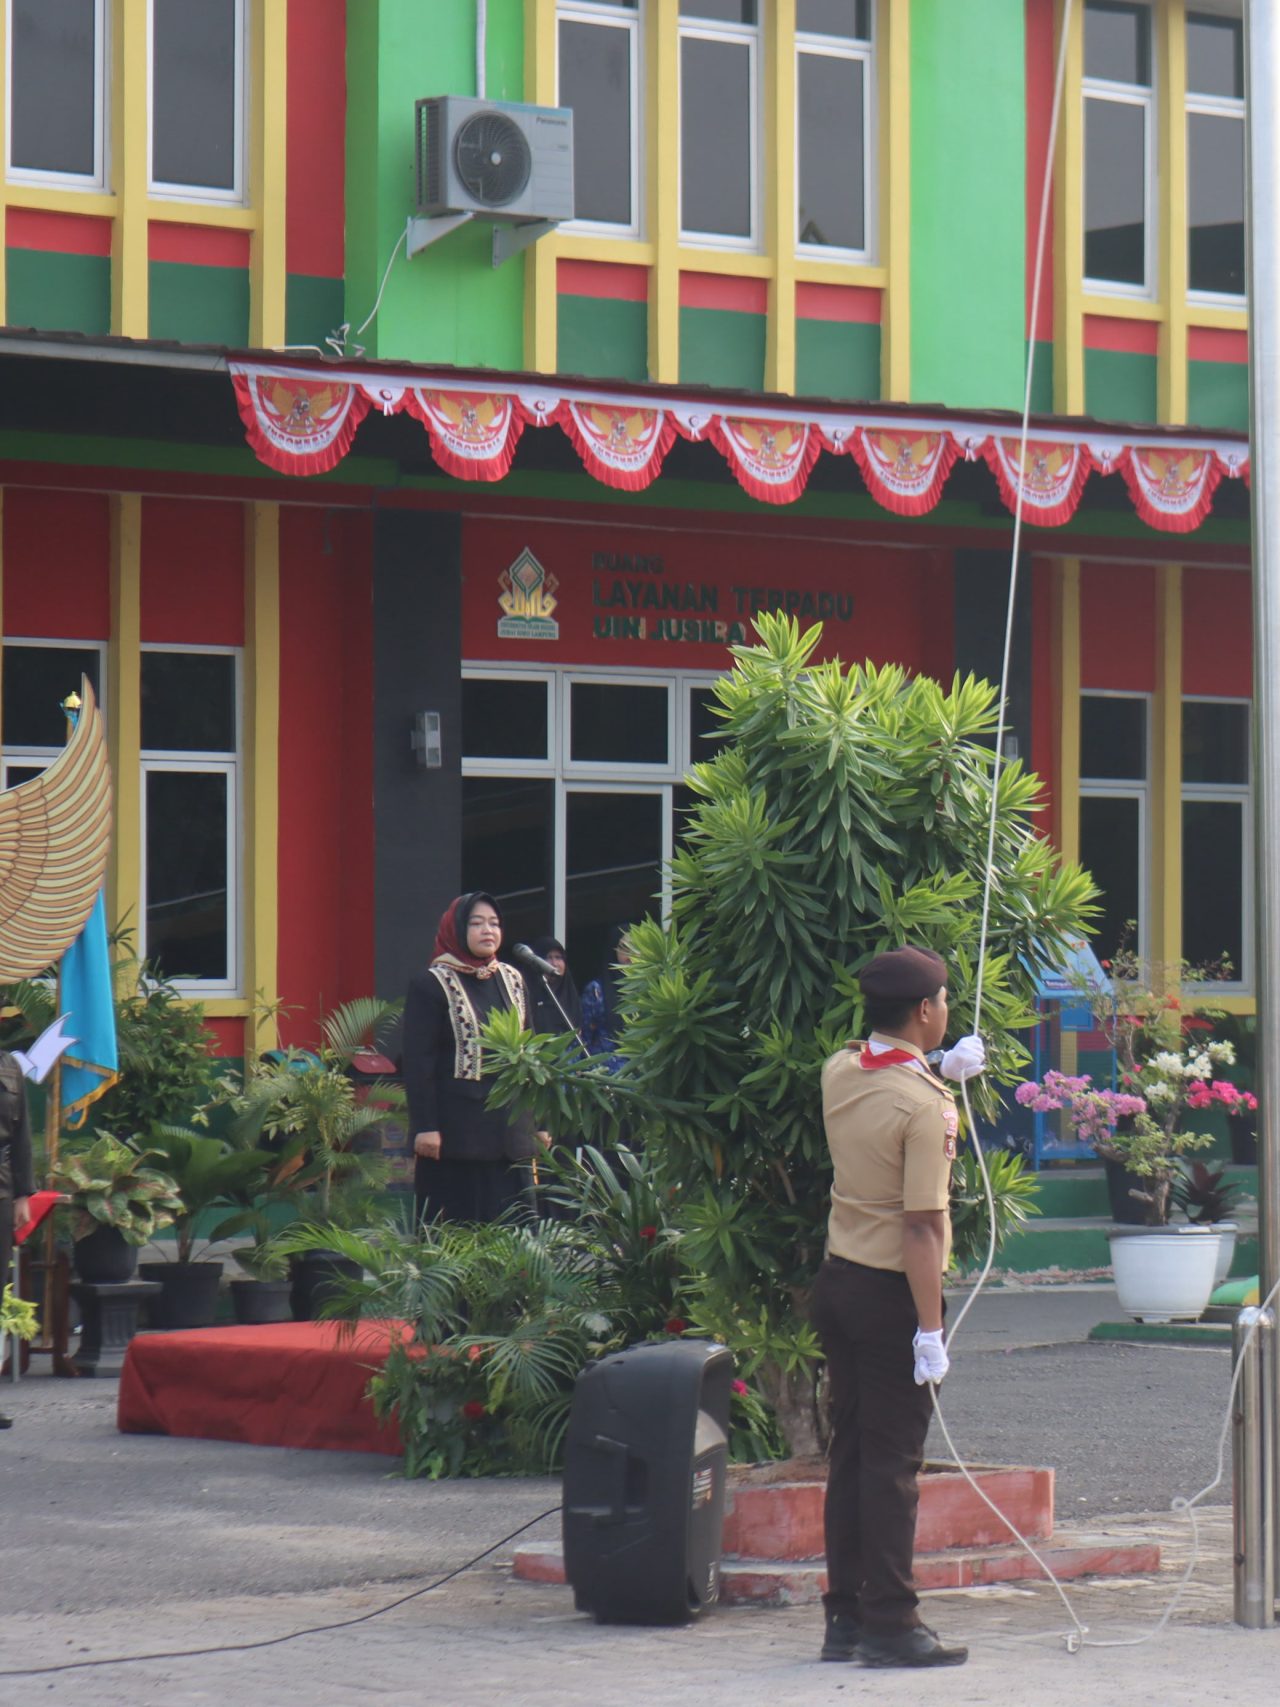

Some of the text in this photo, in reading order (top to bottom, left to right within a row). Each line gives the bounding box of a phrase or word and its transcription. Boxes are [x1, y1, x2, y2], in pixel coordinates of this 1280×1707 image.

[592, 577, 854, 621] LAYANAN TERPADU
[592, 614, 646, 640] UIN
